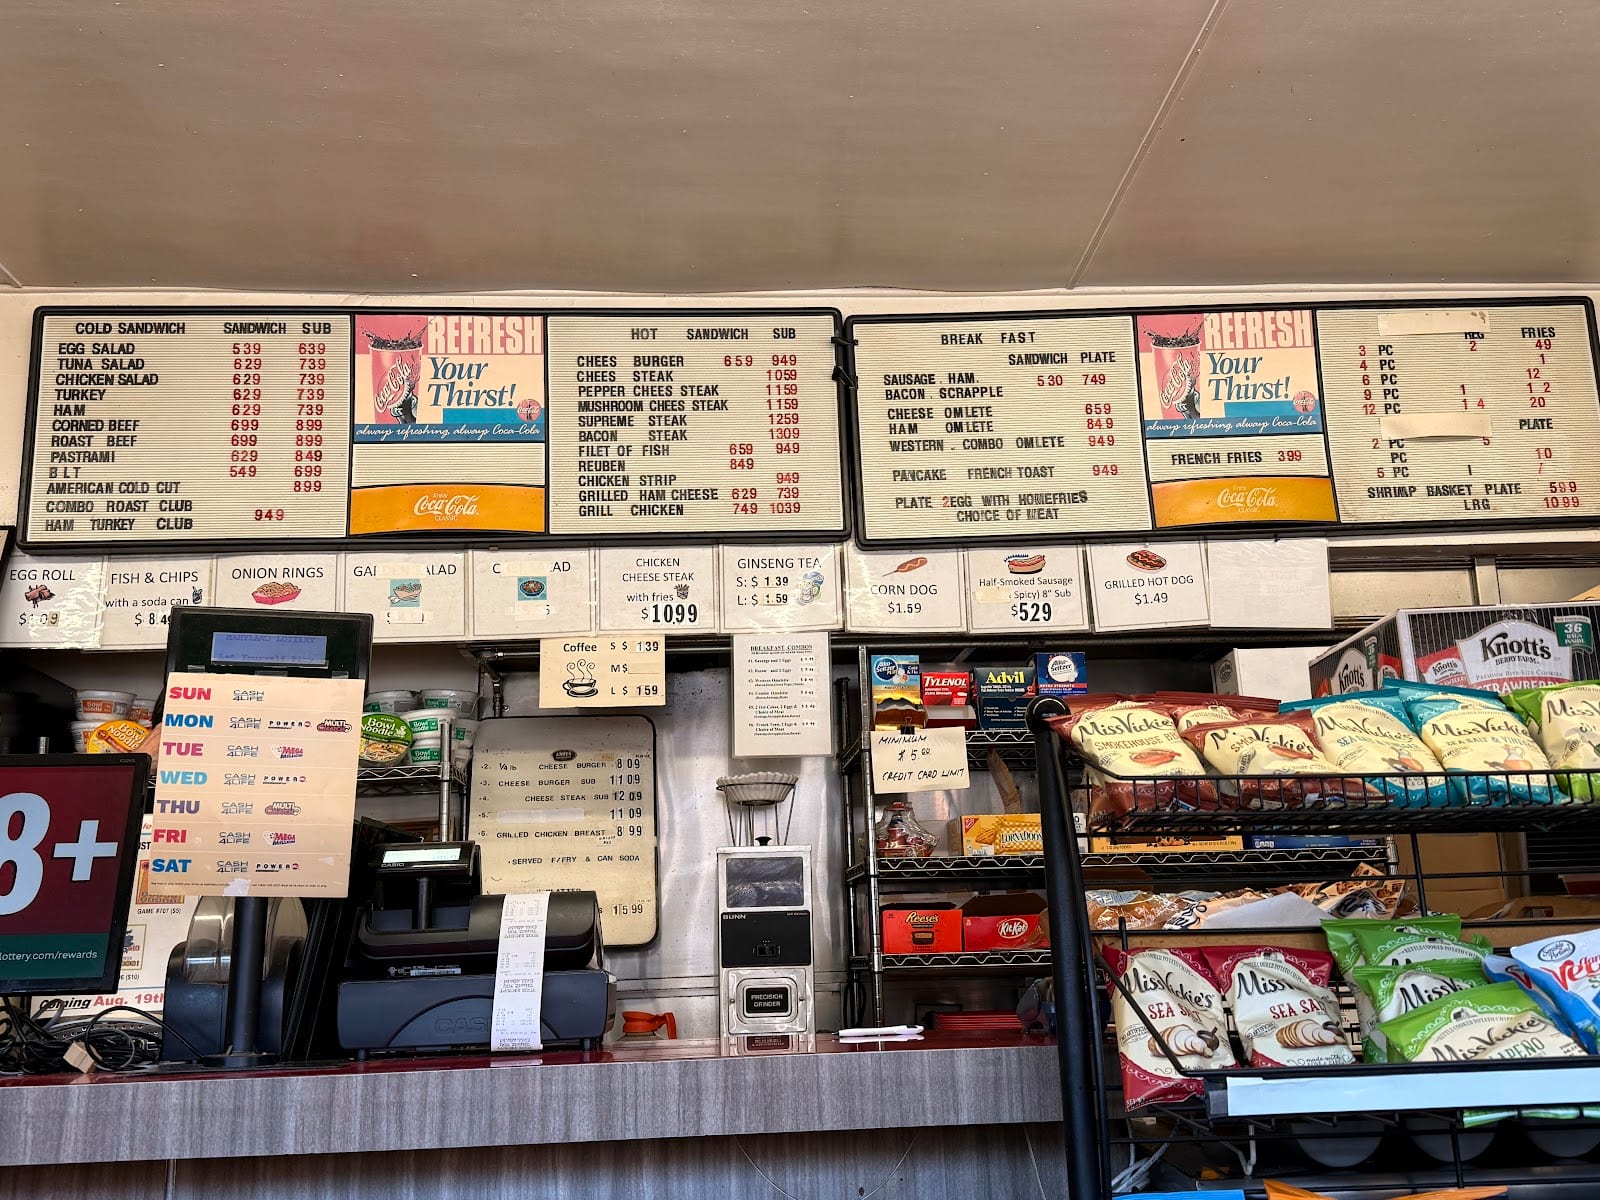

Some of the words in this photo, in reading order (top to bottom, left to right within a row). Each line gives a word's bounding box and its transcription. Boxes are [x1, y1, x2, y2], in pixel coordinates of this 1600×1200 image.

[76, 323, 112, 334] COLD
[118, 323, 185, 334] SANDWICH
[224, 323, 286, 334] SANDWICH
[302, 323, 331, 334] SUB
[631, 328, 658, 340] HOT
[687, 328, 748, 340] SANDWICH
[773, 328, 796, 340] SUB
[1205, 311, 1313, 349] REFRESH
[1521, 327, 1555, 338] FRIES
[427, 317, 541, 354] REFRESH
[941, 333, 983, 345] BREAK
[1001, 332, 1036, 343] FAST
[58, 343, 84, 354] EGG
[92, 343, 135, 354] SALAD
[232, 343, 261, 354] 539
[299, 343, 325, 354] 639
[577, 356, 617, 367] CHEES
[633, 356, 684, 367] BURGER
[724, 356, 753, 367] 659
[772, 356, 796, 366] 949
[1009, 354, 1068, 365] SANDWICH
[1081, 352, 1115, 363] PLATE
[1207, 353, 1263, 374] Your
[428, 357, 488, 379] Your
[56, 374, 114, 385] CHICKEN
[118, 374, 158, 385] SALAD
[233, 374, 260, 385] 629
[299, 374, 324, 385] 739
[428, 382, 516, 407] Thirst!
[578, 386, 625, 397] PEPPER
[634, 386, 672, 396] CHEES
[680, 386, 719, 396] STEAK
[766, 385, 797, 396] 1159
[1208, 376, 1290, 401] Thirst!
[888, 408, 933, 419] CHEESE
[945, 407, 992, 418] OMLETE
[1085, 404, 1111, 415] 659
[52, 420, 104, 431] CORNED
[109, 420, 139, 431] BEEF
[231, 420, 259, 431] 699
[296, 420, 322, 430] 899
[578, 416, 634, 427] SUPREME
[648, 415, 687, 426] STEAK
[768, 414, 799, 425] 1259
[890, 423, 918, 435] HAM
[946, 422, 993, 433] OMLETE
[1087, 418, 1113, 429] 849
[1519, 419, 1553, 430] PLATE
[356, 427, 393, 440] always
[453, 426, 489, 440] always
[493, 424, 540, 434] Coca-Cola
[579, 446, 610, 457] FILET
[618, 446, 632, 456] OF
[643, 445, 670, 456] FISH
[730, 444, 753, 455] 659
[776, 444, 799, 454] 949
[1172, 452, 1220, 465] FRENCH
[1228, 451, 1262, 463] FRIES
[1278, 450, 1302, 461] 399
[46, 483, 113, 494] AMERICAN
[119, 482, 149, 494] COLD
[157, 482, 180, 494] CUT
[294, 481, 321, 492] 899
[1368, 487, 1416, 498] SHRIMP
[1427, 484, 1472, 496] BASKET
[1485, 483, 1521, 495] PLATE
[579, 491, 628, 502] GRILLED
[640, 490, 666, 501] HAM
[672, 489, 718, 500] CHEESE
[732, 489, 757, 500] 629
[778, 488, 799, 498] 739
[1217, 487, 1278, 507] Coca-Cola
[414, 495, 479, 515] Coca-Cola
[1464, 499, 1490, 510] LRG
[1544, 497, 1580, 508] 1099
[957, 510, 1000, 522] CHOICE
[1007, 509, 1021, 521] OF
[1027, 508, 1059, 520] MEAT
[636, 558, 680, 567] CHICKEN
[737, 558, 794, 569] GINSENG
[798, 557, 821, 568] TEA
[10, 569, 37, 580] EGG
[43, 569, 75, 580] ROLL
[111, 572, 140, 584] FISH
[144, 572, 154, 582] &
[159, 571, 199, 583] CHIPS
[232, 567, 278, 580] ONION
[282, 566, 324, 579] RINGS
[622, 573, 661, 582] CHEESE
[664, 572, 694, 581] STEAK
[979, 577, 1034, 587] Half-Smoked
[1038, 576, 1073, 587] Sausage
[1105, 578, 1145, 589] GRILLED
[1148, 577, 1168, 587] HOT
[1171, 575, 1193, 585] DOG
[871, 584, 905, 595] CORN
[910, 584, 938, 595] DOG
[106, 598, 129, 608] with
[142, 598, 167, 606] soda
[171, 598, 189, 606] can
[1135, 593, 1168, 605] $1.49
[888, 602, 921, 613] $1.59
[1564, 624, 1583, 633] 36
[564, 643, 597, 652] Coffee
[1481, 633, 1552, 661] Knott's
[1495, 657, 1516, 665] BERRY
[924, 676, 967, 687] TYLENOL
[986, 671, 1024, 684] Advil
[169, 687, 211, 700] SUN
[165, 714, 213, 728] MON
[368, 718, 395, 730] Bowl
[879, 735, 927, 744] MINIMUM
[1094, 736, 1164, 751] SMOKEHOUSE
[163, 742, 203, 756] TUE
[160, 771, 207, 784] WED
[883, 771, 913, 781] CREDIT
[918, 770, 937, 779] CARD
[942, 769, 964, 777] LIMIT
[157, 800, 200, 814] THU
[153, 830, 187, 843] FRI
[152, 859, 192, 872] SAT
[905, 911, 939, 923] Reese's
[94, 996, 127, 1006] Aug.
[1148, 1002, 1175, 1020] SEA
[1270, 1002, 1297, 1019] SEA
